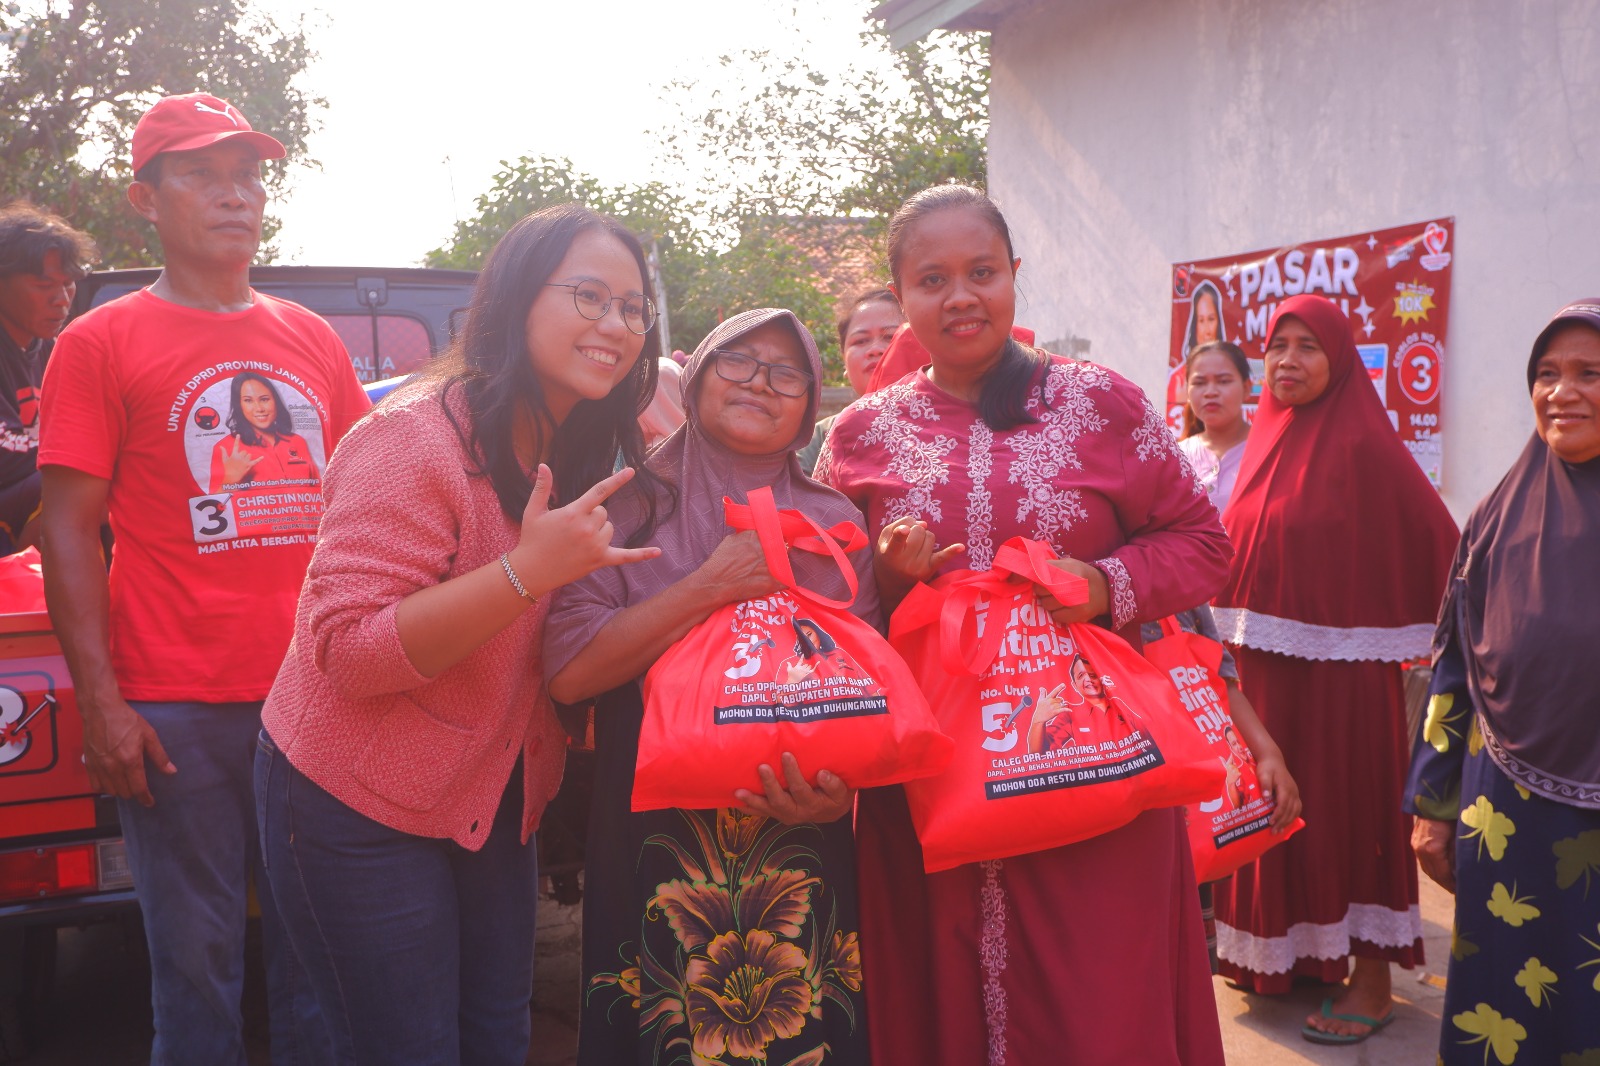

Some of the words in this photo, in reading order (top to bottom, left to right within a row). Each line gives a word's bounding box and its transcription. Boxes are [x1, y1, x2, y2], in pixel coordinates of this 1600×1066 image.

[1240, 247, 1359, 307] PASAR
[1399, 296, 1425, 312] 10K
[1411, 355, 1432, 391] 3
[167, 391, 191, 432] UNTUK
[186, 367, 216, 391] DPRD
[216, 361, 273, 372] PROVINSI
[275, 367, 305, 390] JAWA
[306, 387, 328, 423] BARAT
[1410, 413, 1438, 427] 14.00
[222, 482, 250, 490] Mohon
[280, 478, 320, 486] Dukungannya
[236, 494, 296, 508] CHRISTIN
[297, 493, 324, 503] NOVA
[195, 499, 229, 536] 3
[198, 543, 229, 555] MARI
[231, 538, 259, 549] KITA
[261, 535, 307, 547] BERSATU,
[724, 635, 762, 680] 3
[1019, 655, 1056, 673] M.H.
[724, 683, 754, 695] CALEG
[777, 680, 821, 694] PROVINSI
[824, 676, 848, 687] JAWA
[742, 694, 769, 703] DAPIL
[833, 686, 863, 697] BEKASI
[980, 689, 1002, 700] No.
[1004, 685, 1030, 696] Urut
[719, 709, 753, 720] MOHON
[755, 707, 774, 718] DOA
[775, 707, 800, 718] RESTU
[802, 704, 822, 717] DAN
[823, 699, 887, 713] DUKUNGANNYA
[981, 702, 1019, 753] 5
[992, 757, 1021, 768] CALEG
[1023, 751, 1055, 763] DPR-RI
[1056, 745, 1097, 758] PROVINSI
[1013, 766, 1028, 774] KAB.
[992, 781, 1026, 793] MOHON
[1027, 778, 1046, 788] DOA
[1048, 773, 1075, 785] RESTU
[1078, 769, 1096, 780] DAN
[1212, 812, 1231, 824] CALEG
